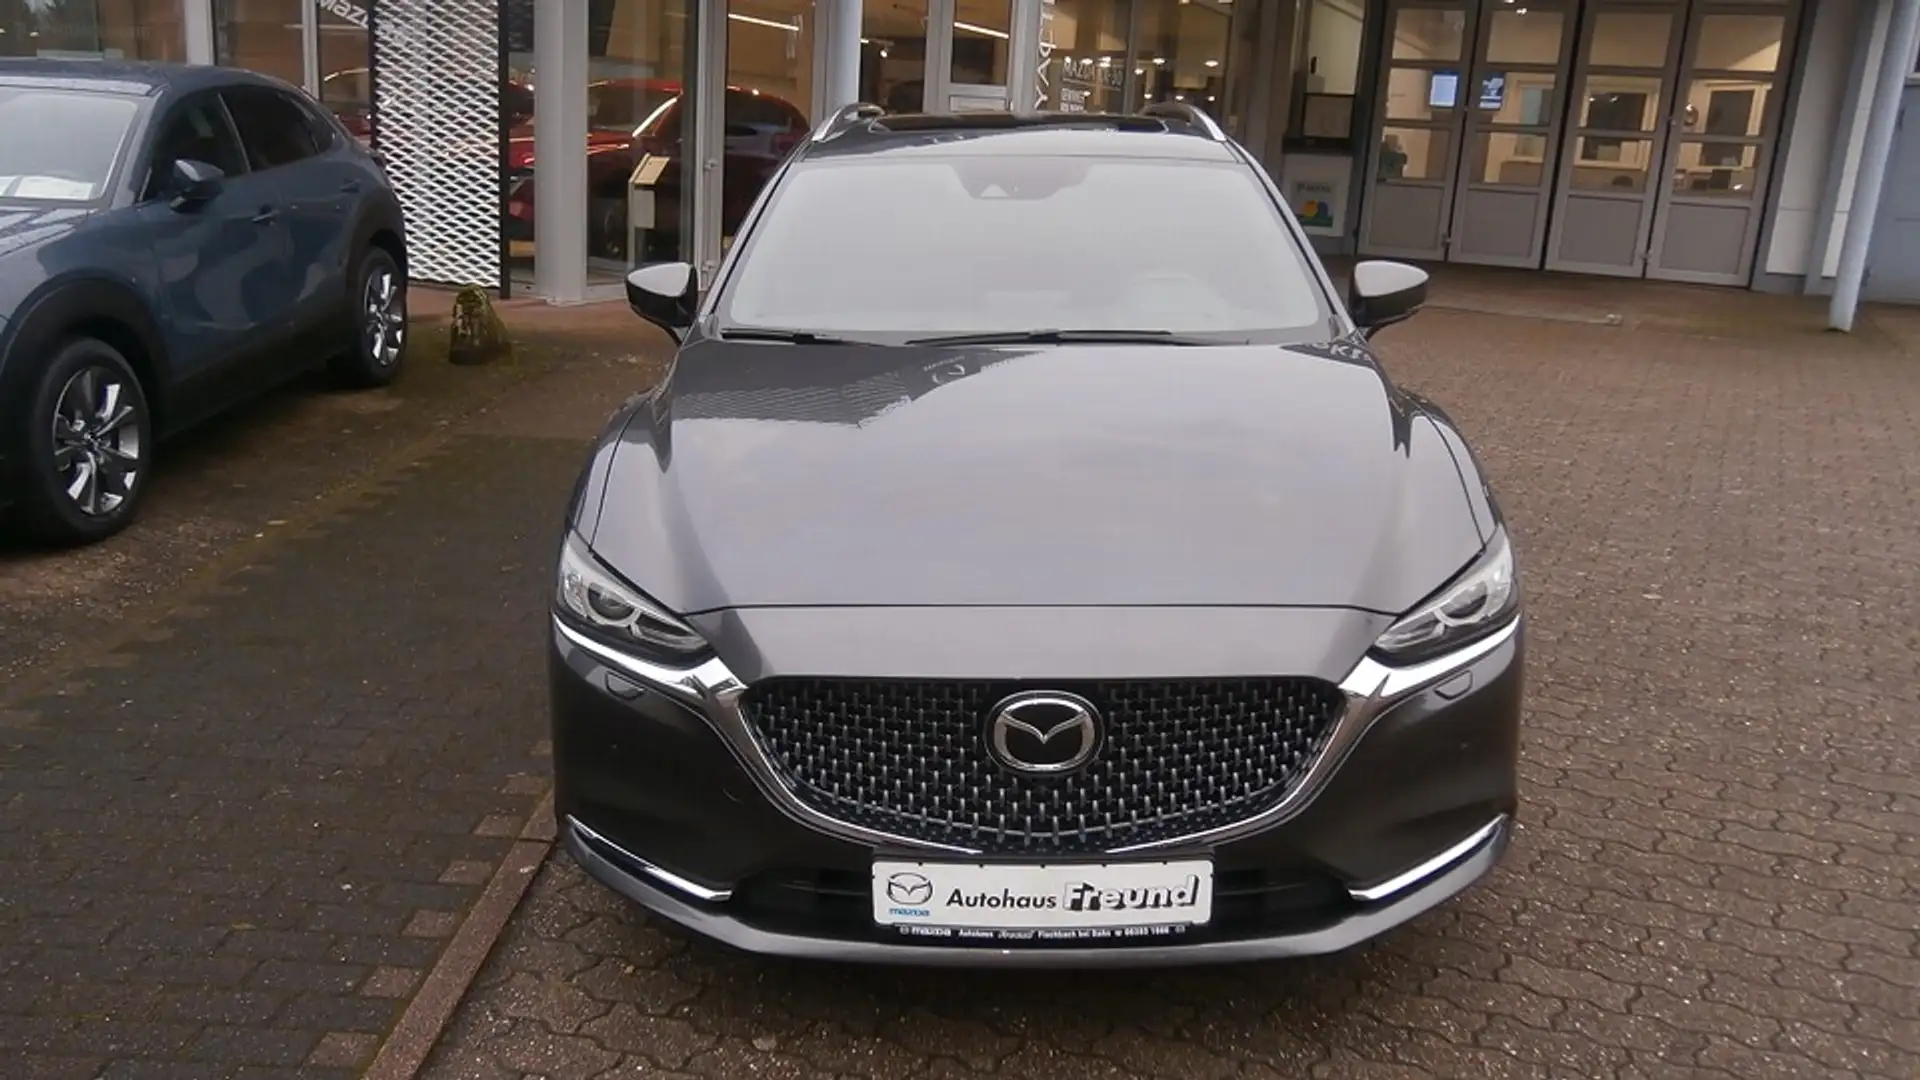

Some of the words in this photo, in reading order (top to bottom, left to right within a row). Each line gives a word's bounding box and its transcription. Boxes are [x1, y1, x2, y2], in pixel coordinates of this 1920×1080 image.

[946, 887, 1057, 909] Autohaus
[1062, 874, 1200, 911] Freund
[958, 927, 994, 938] Autohaus
